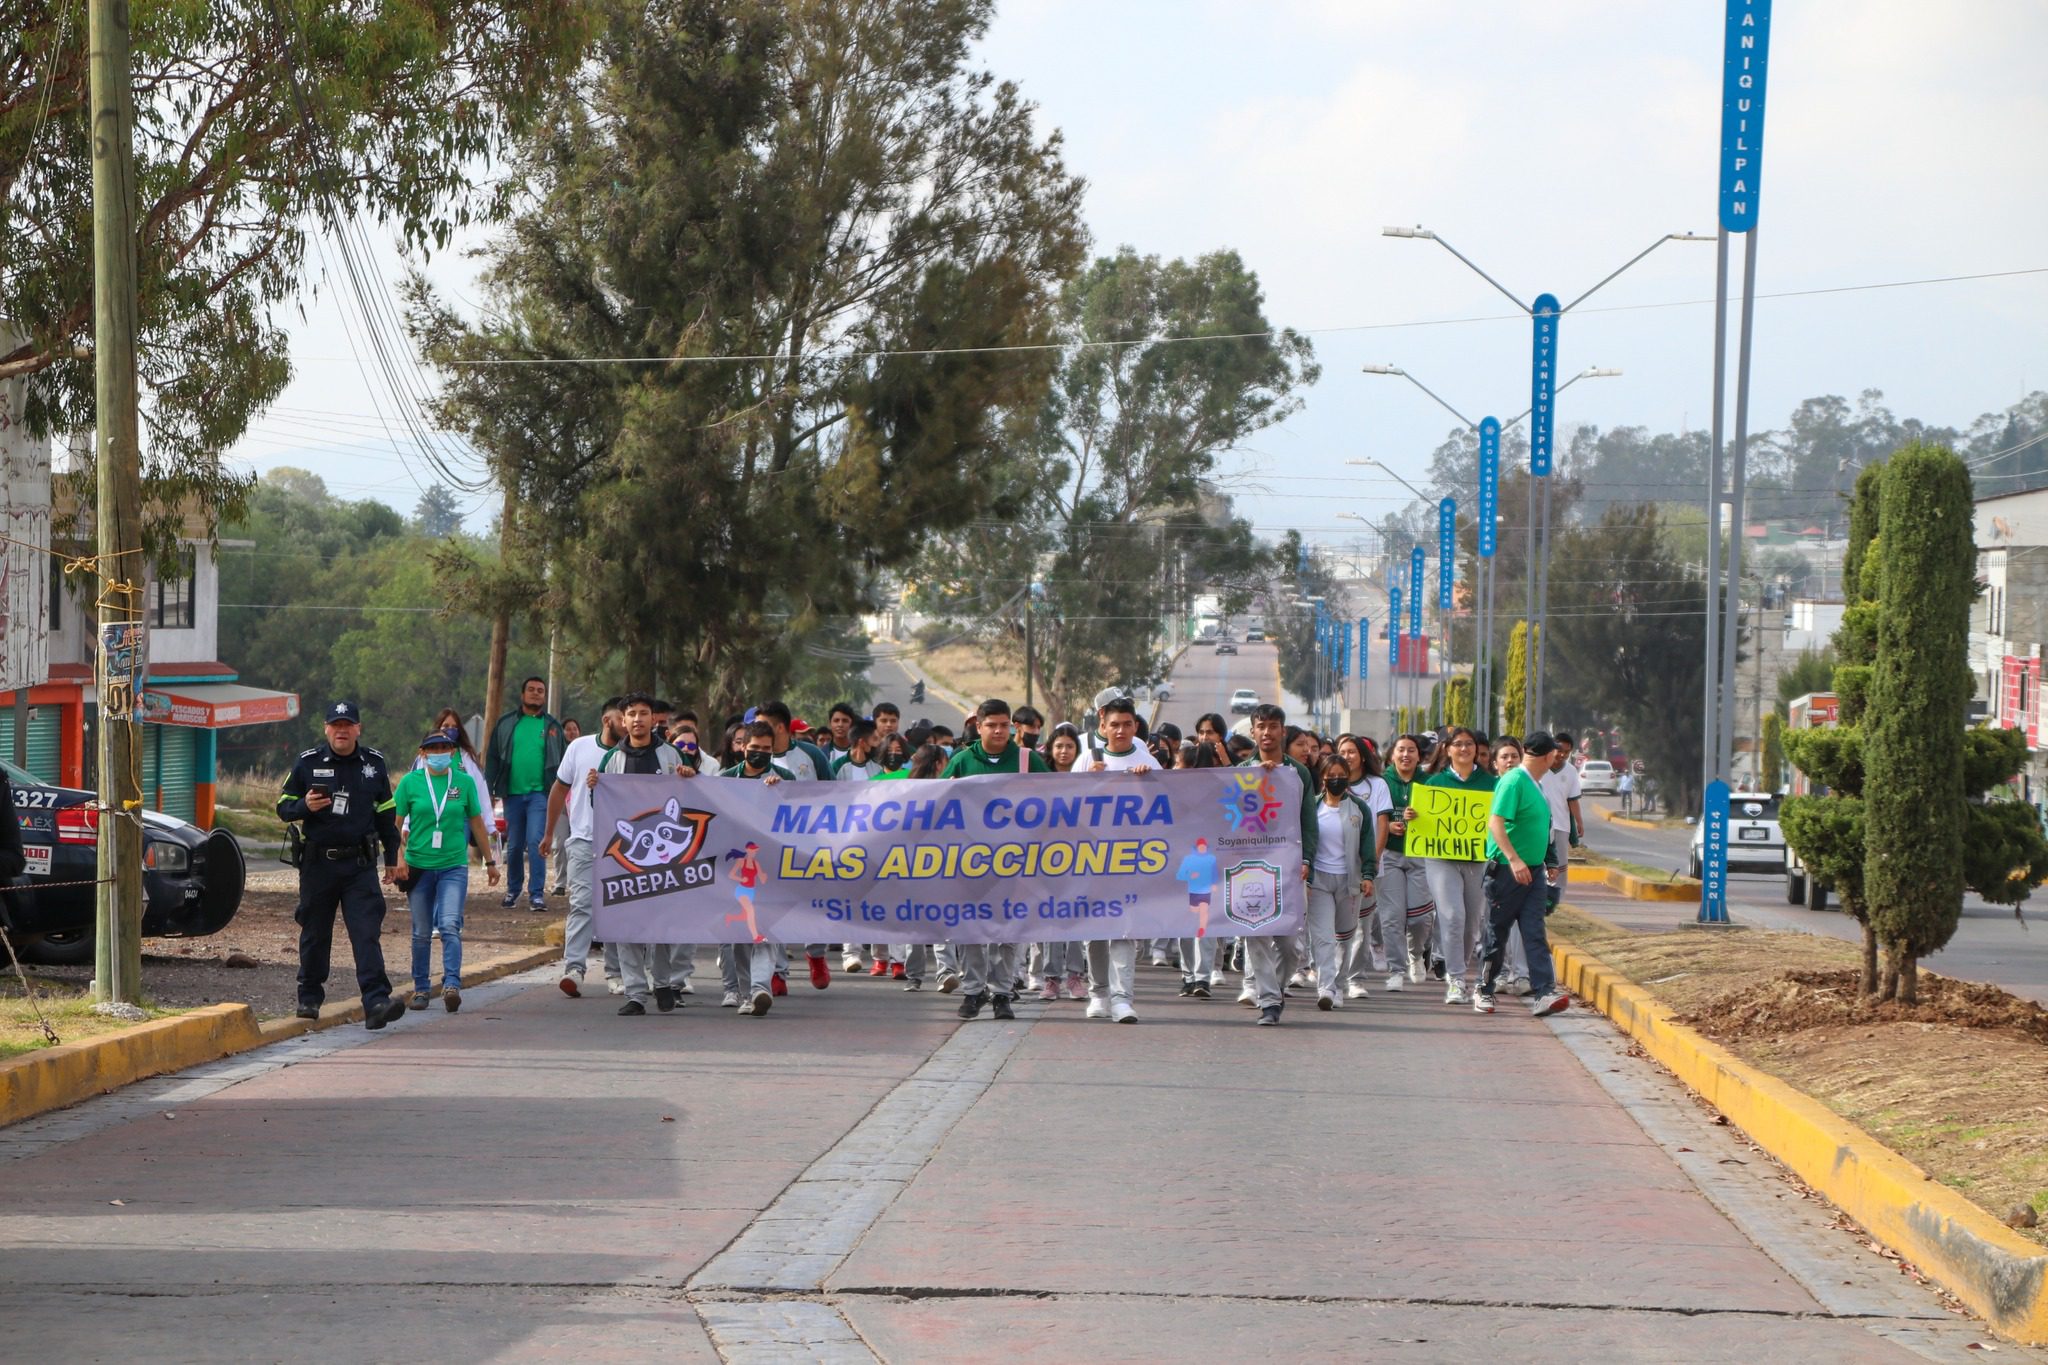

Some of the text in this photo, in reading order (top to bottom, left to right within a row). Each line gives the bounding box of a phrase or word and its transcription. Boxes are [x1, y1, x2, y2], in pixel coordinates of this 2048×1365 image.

[1732, 0, 1755, 216] ANIQUILPAN
[1537, 324, 1549, 467] SOYANIQUILPAN
[1484, 439, 1493, 550] SOYANIQUILPAN
[171, 704, 205, 715] PESCADOS
[172, 713, 207, 723] MARISCOS
[11, 788, 58, 808] 327
[1244, 793, 1258, 812] S
[1428, 789, 1485, 820] Dile
[771, 794, 1174, 834] MARCHA CONTRA
[1436, 818, 1468, 837] NO
[1218, 835, 1286, 847] Soyaniquilpan
[778, 838, 1169, 880] LAS ADICCIONES
[606, 863, 713, 900] PREPA 80
[860, 899, 886, 921] te
[896, 898, 993, 927] drogas
[1002, 897, 1028, 919] te
